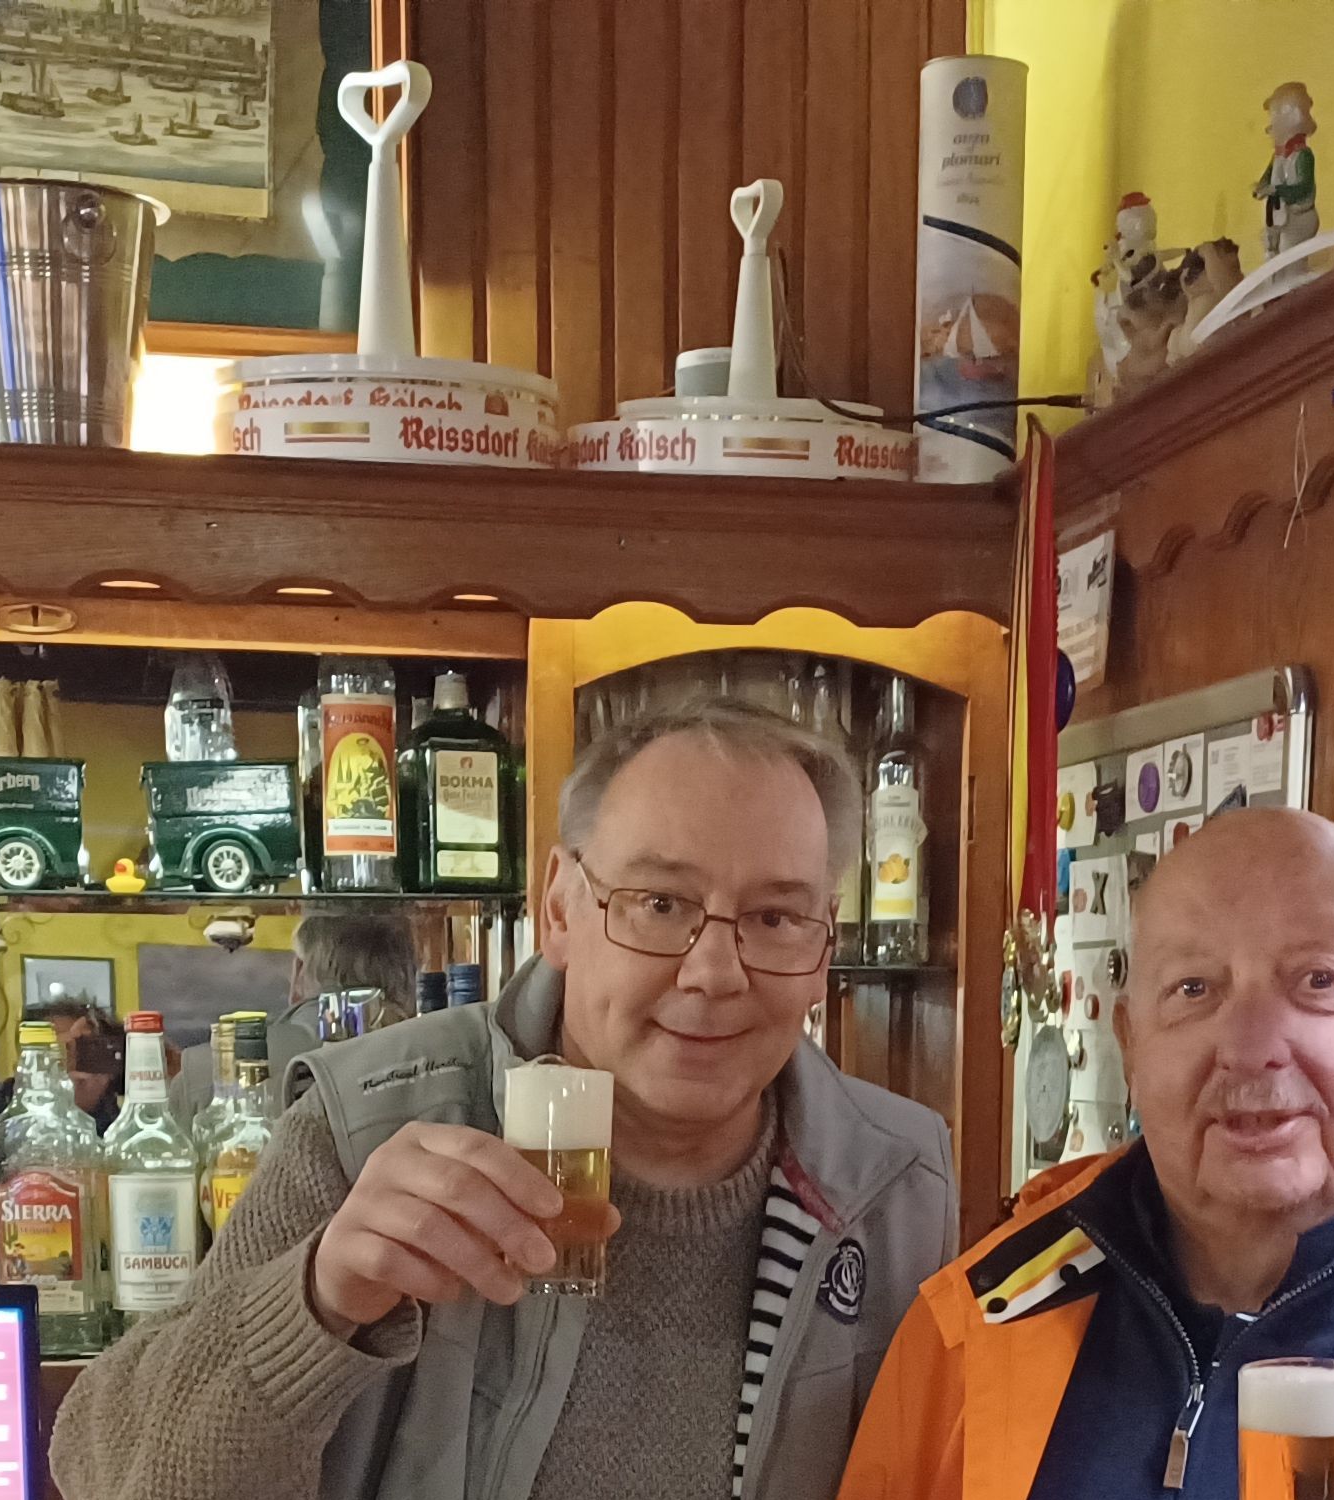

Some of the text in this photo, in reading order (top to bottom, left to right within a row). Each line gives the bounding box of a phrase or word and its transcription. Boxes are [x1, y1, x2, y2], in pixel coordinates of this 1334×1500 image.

[233, 417, 262, 453] sch
[399, 416, 519, 458] Reissdorf
[616, 427, 697, 466] Kölsch
[439, 775, 494, 789] BOKMA
[1, 1199, 73, 1222] SIERRA
[123, 1256, 188, 1270] SAMBUCA
